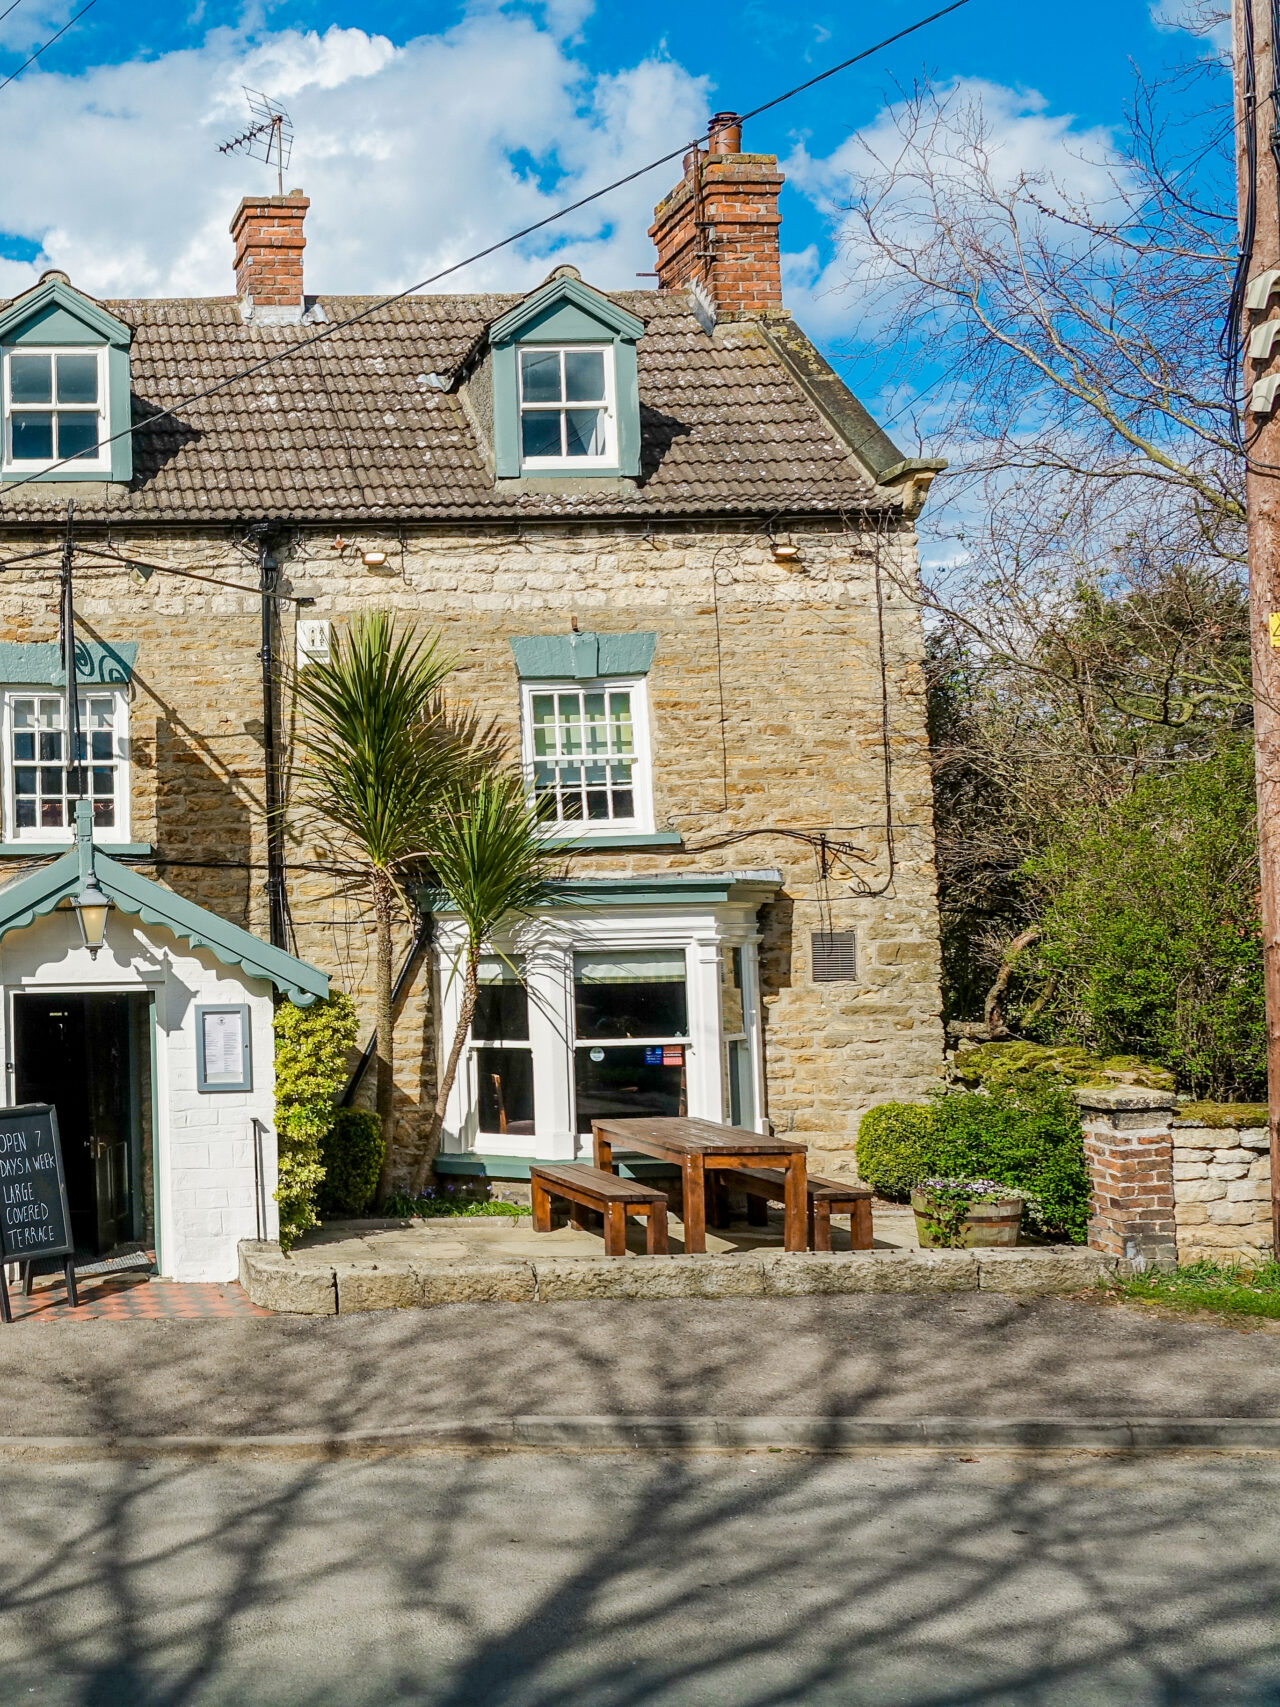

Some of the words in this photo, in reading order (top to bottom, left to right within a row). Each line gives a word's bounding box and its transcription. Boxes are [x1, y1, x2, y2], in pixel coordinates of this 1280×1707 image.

[34, 1130, 41, 1148] 7
[0, 1157, 24, 1178] DAYS
[25, 1157, 32, 1174] A
[32, 1152, 56, 1170] WEEK
[3, 1182, 35, 1204] LARGE
[6, 1202, 49, 1225] COVERED
[7, 1225, 55, 1249] TERRACE
